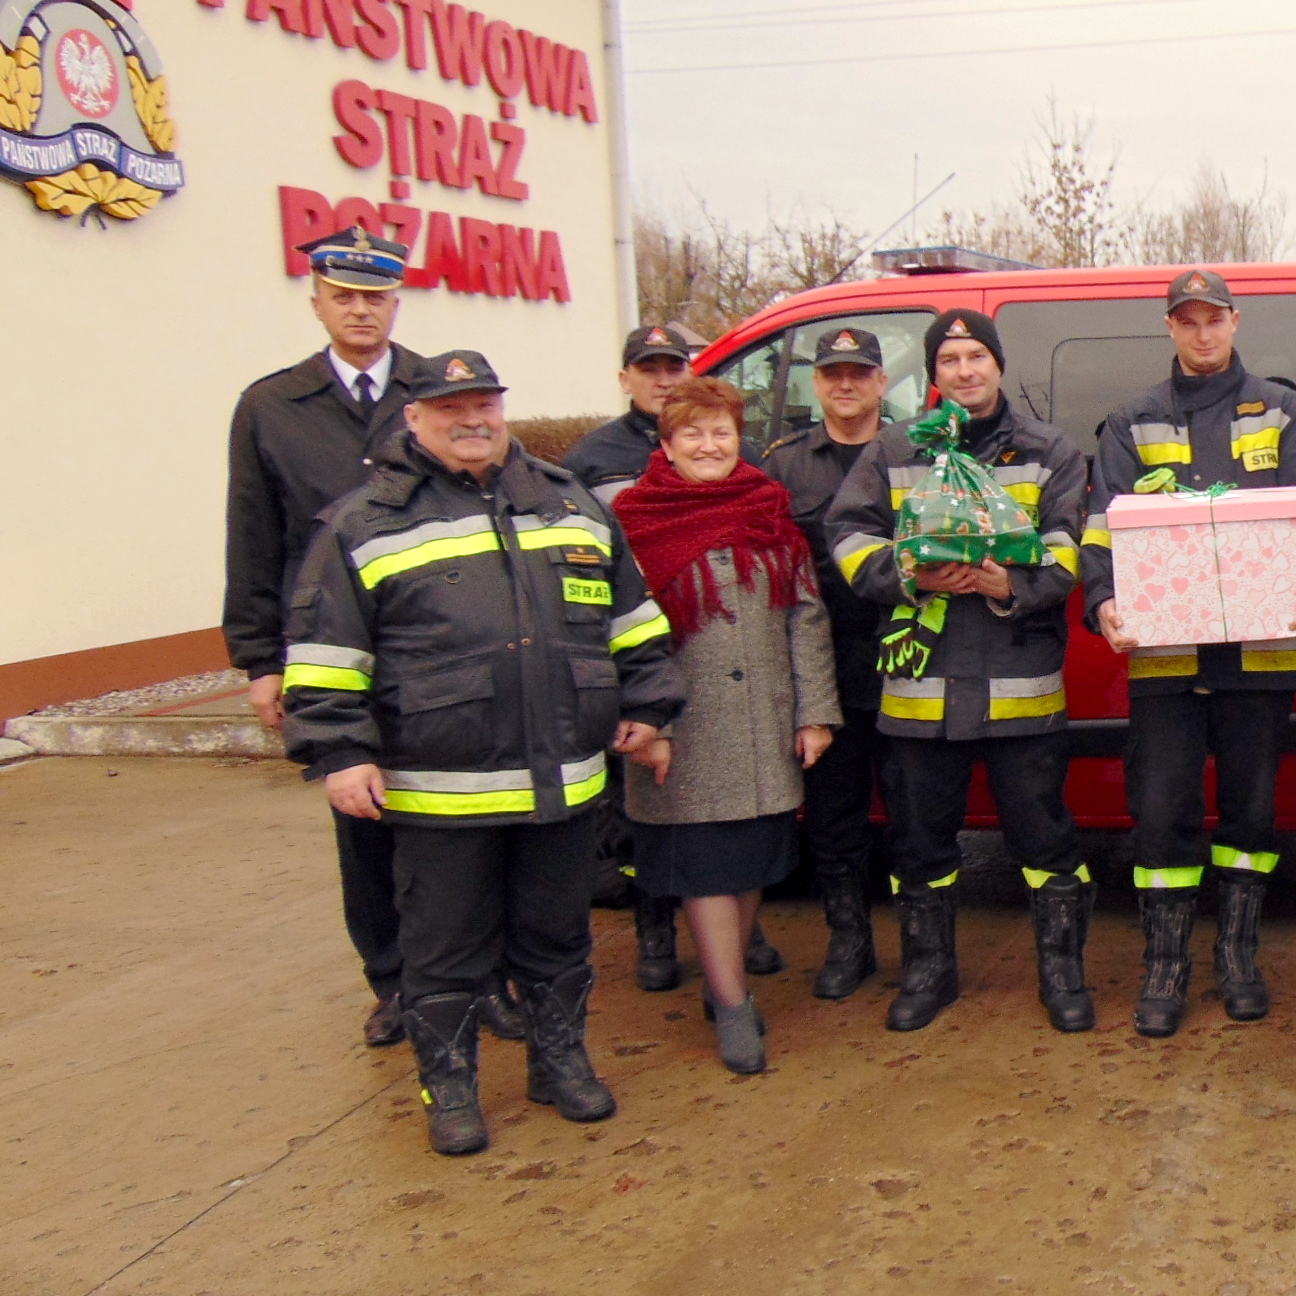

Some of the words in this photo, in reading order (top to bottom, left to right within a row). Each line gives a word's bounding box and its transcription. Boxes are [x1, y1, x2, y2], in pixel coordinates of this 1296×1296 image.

[1, 137, 75, 170] PAŃSTWOWA
[76, 132, 117, 163] STRAŻ
[129, 154, 182, 186] POŻARNA
[332, 80, 529, 200] STRAŻ
